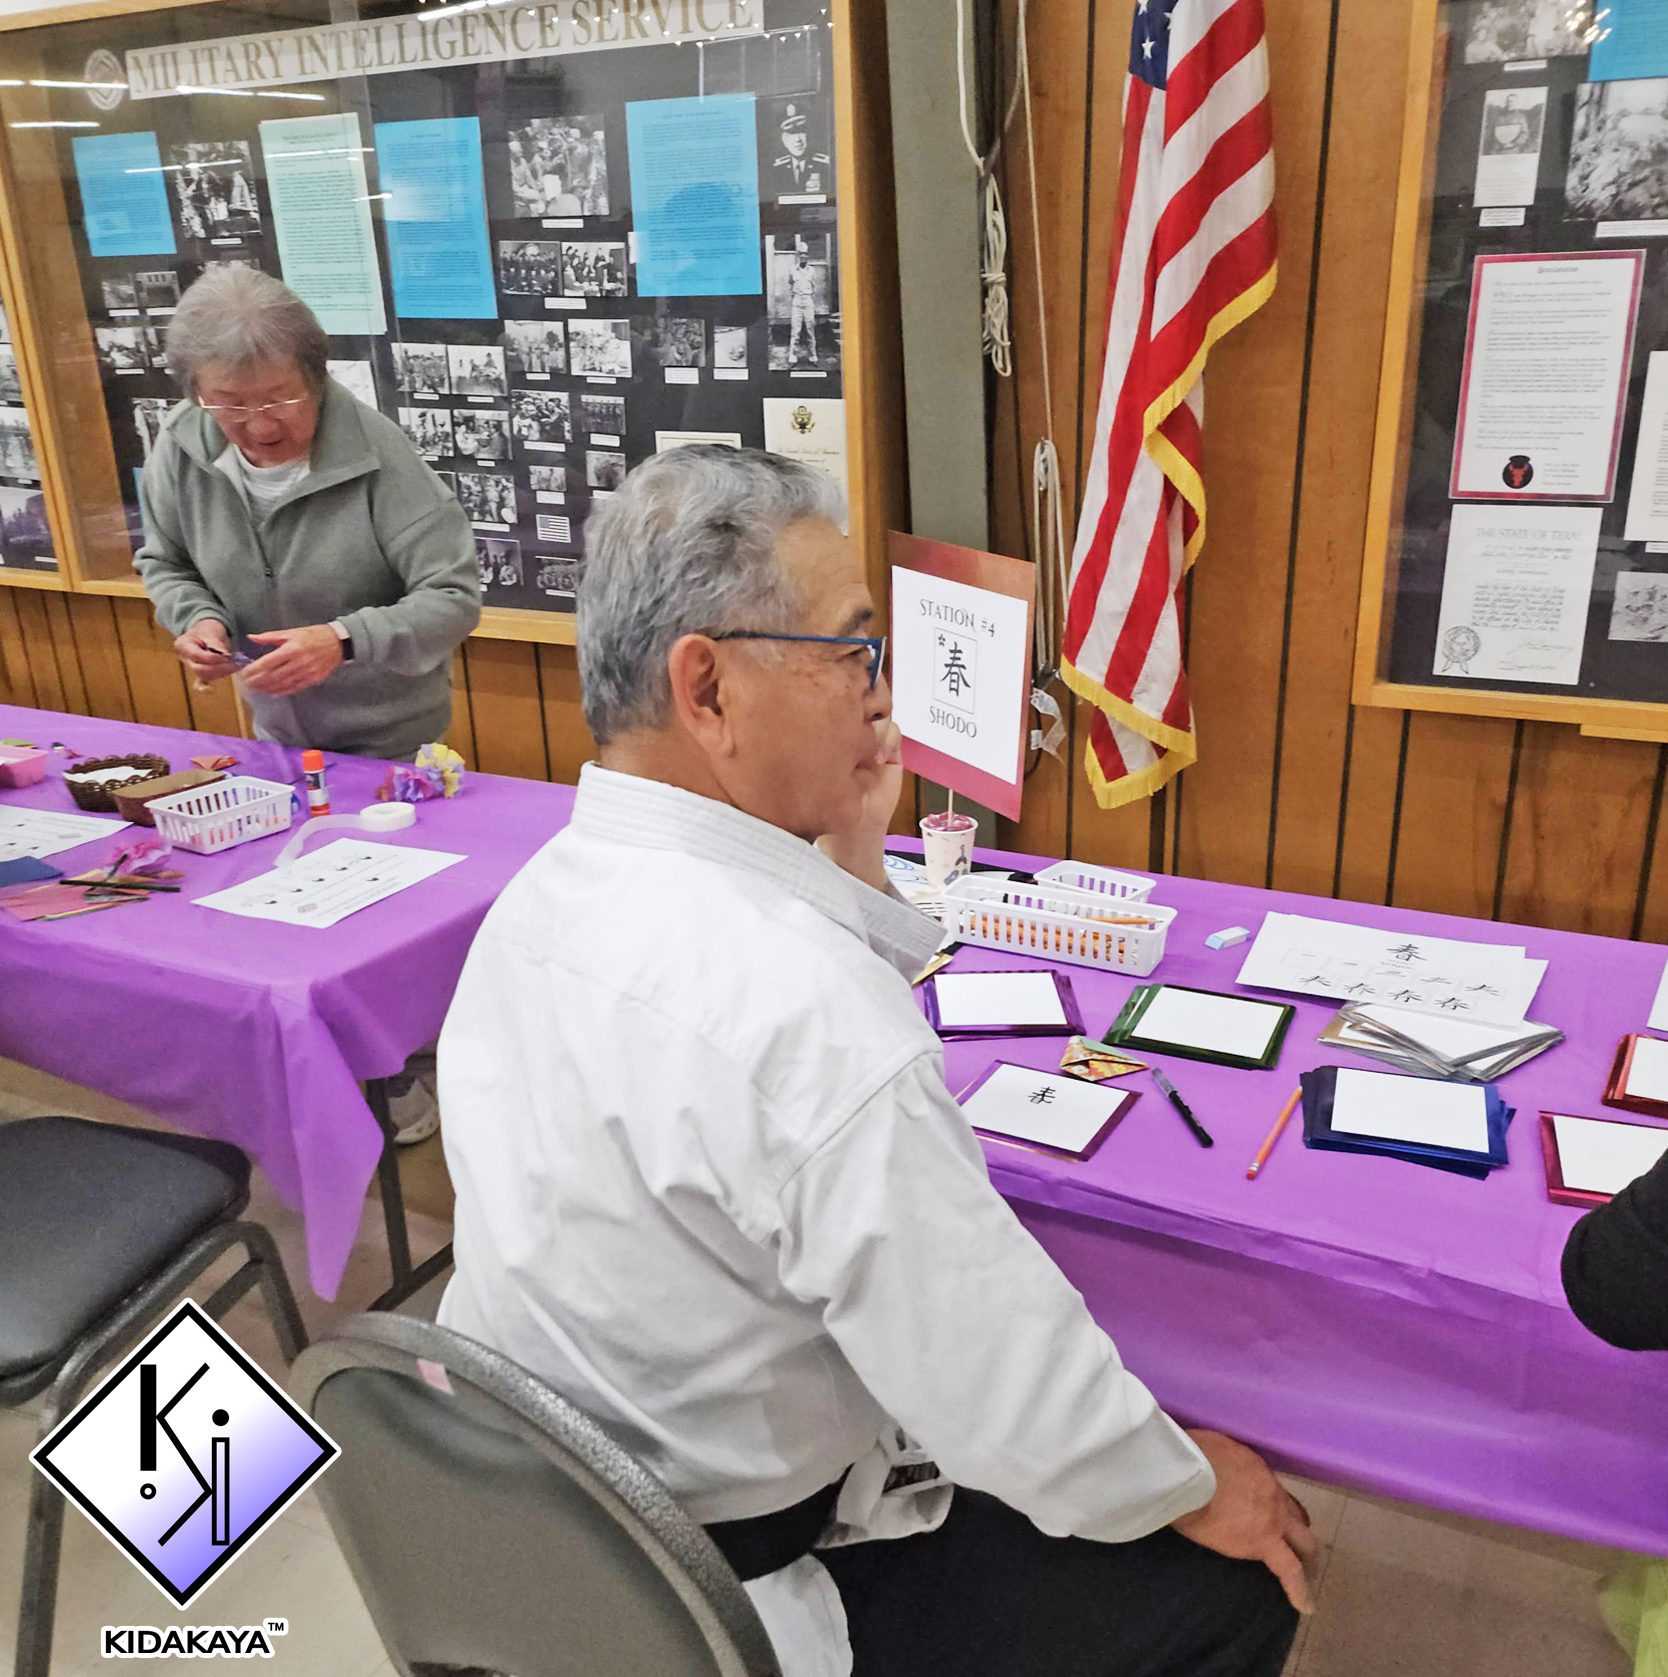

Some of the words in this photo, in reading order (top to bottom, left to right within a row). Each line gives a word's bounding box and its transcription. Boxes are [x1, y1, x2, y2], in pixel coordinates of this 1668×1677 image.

[131, 38, 284, 92] MILITARY
[293, 4, 561, 76] INTELLIGENCE
[572, 0, 754, 46] SERVICE
[919, 598, 978, 634] STATION
[939, 641, 972, 697] 春
[929, 705, 978, 739] SHODO
